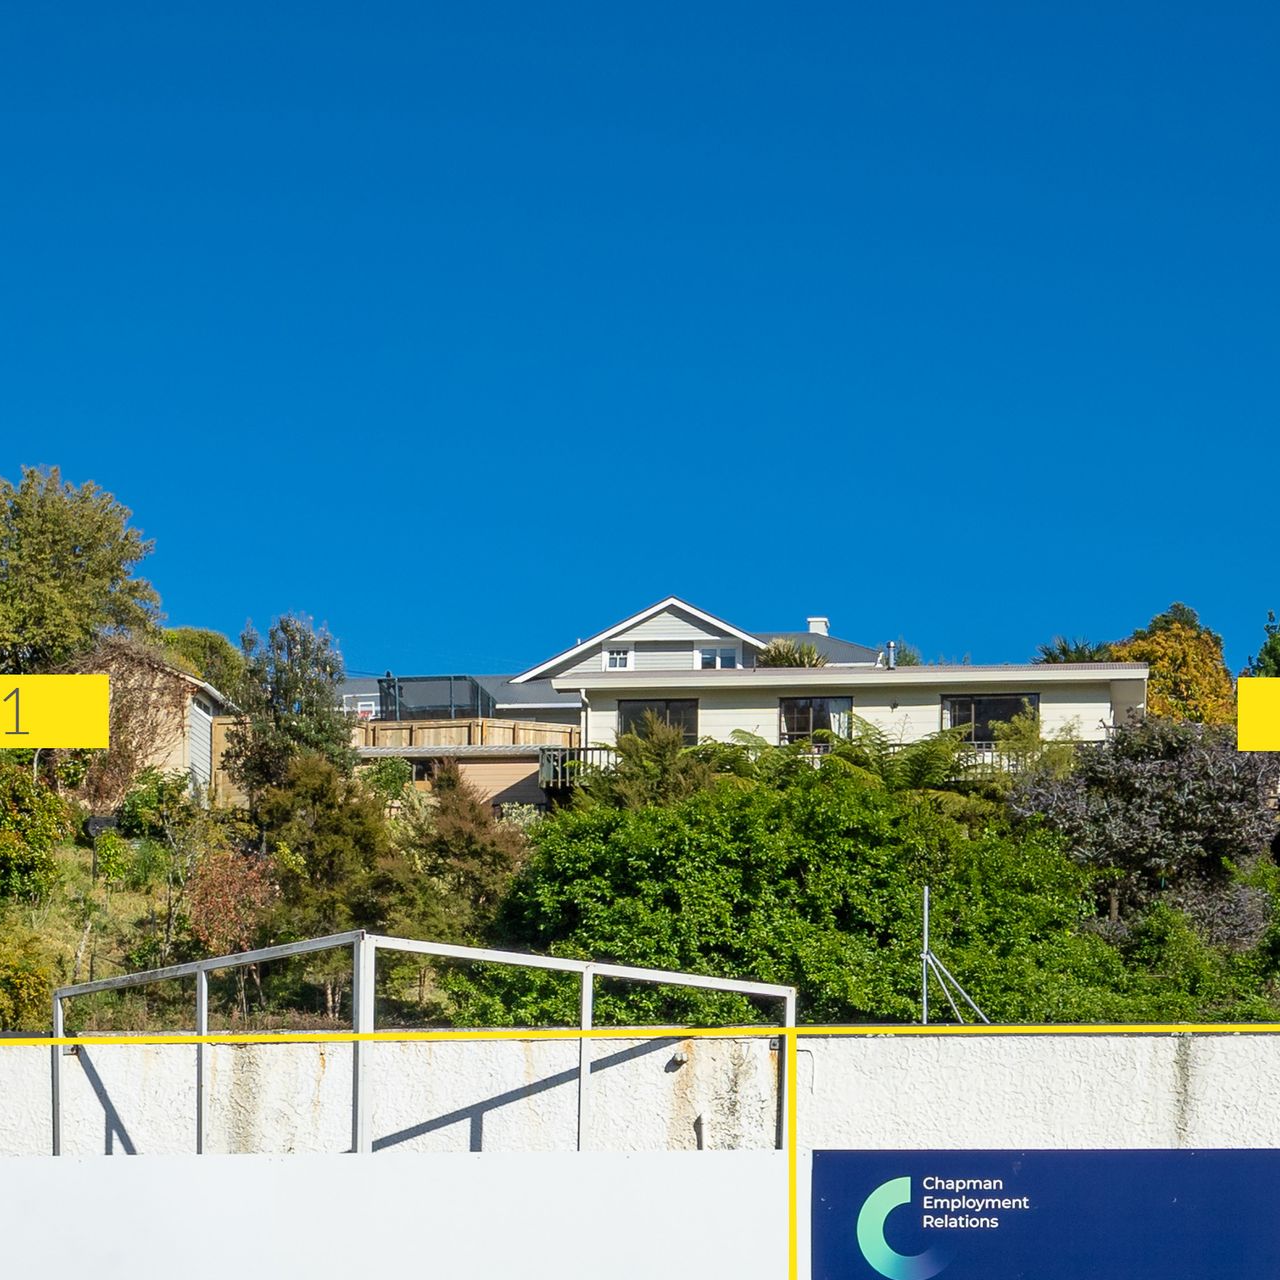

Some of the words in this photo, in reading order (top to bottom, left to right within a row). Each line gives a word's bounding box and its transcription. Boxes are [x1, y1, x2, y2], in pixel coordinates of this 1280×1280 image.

[922, 1176, 1003, 1193] Chapman
[922, 1195, 1030, 1212] Employment
[922, 1214, 999, 1228] Relations
